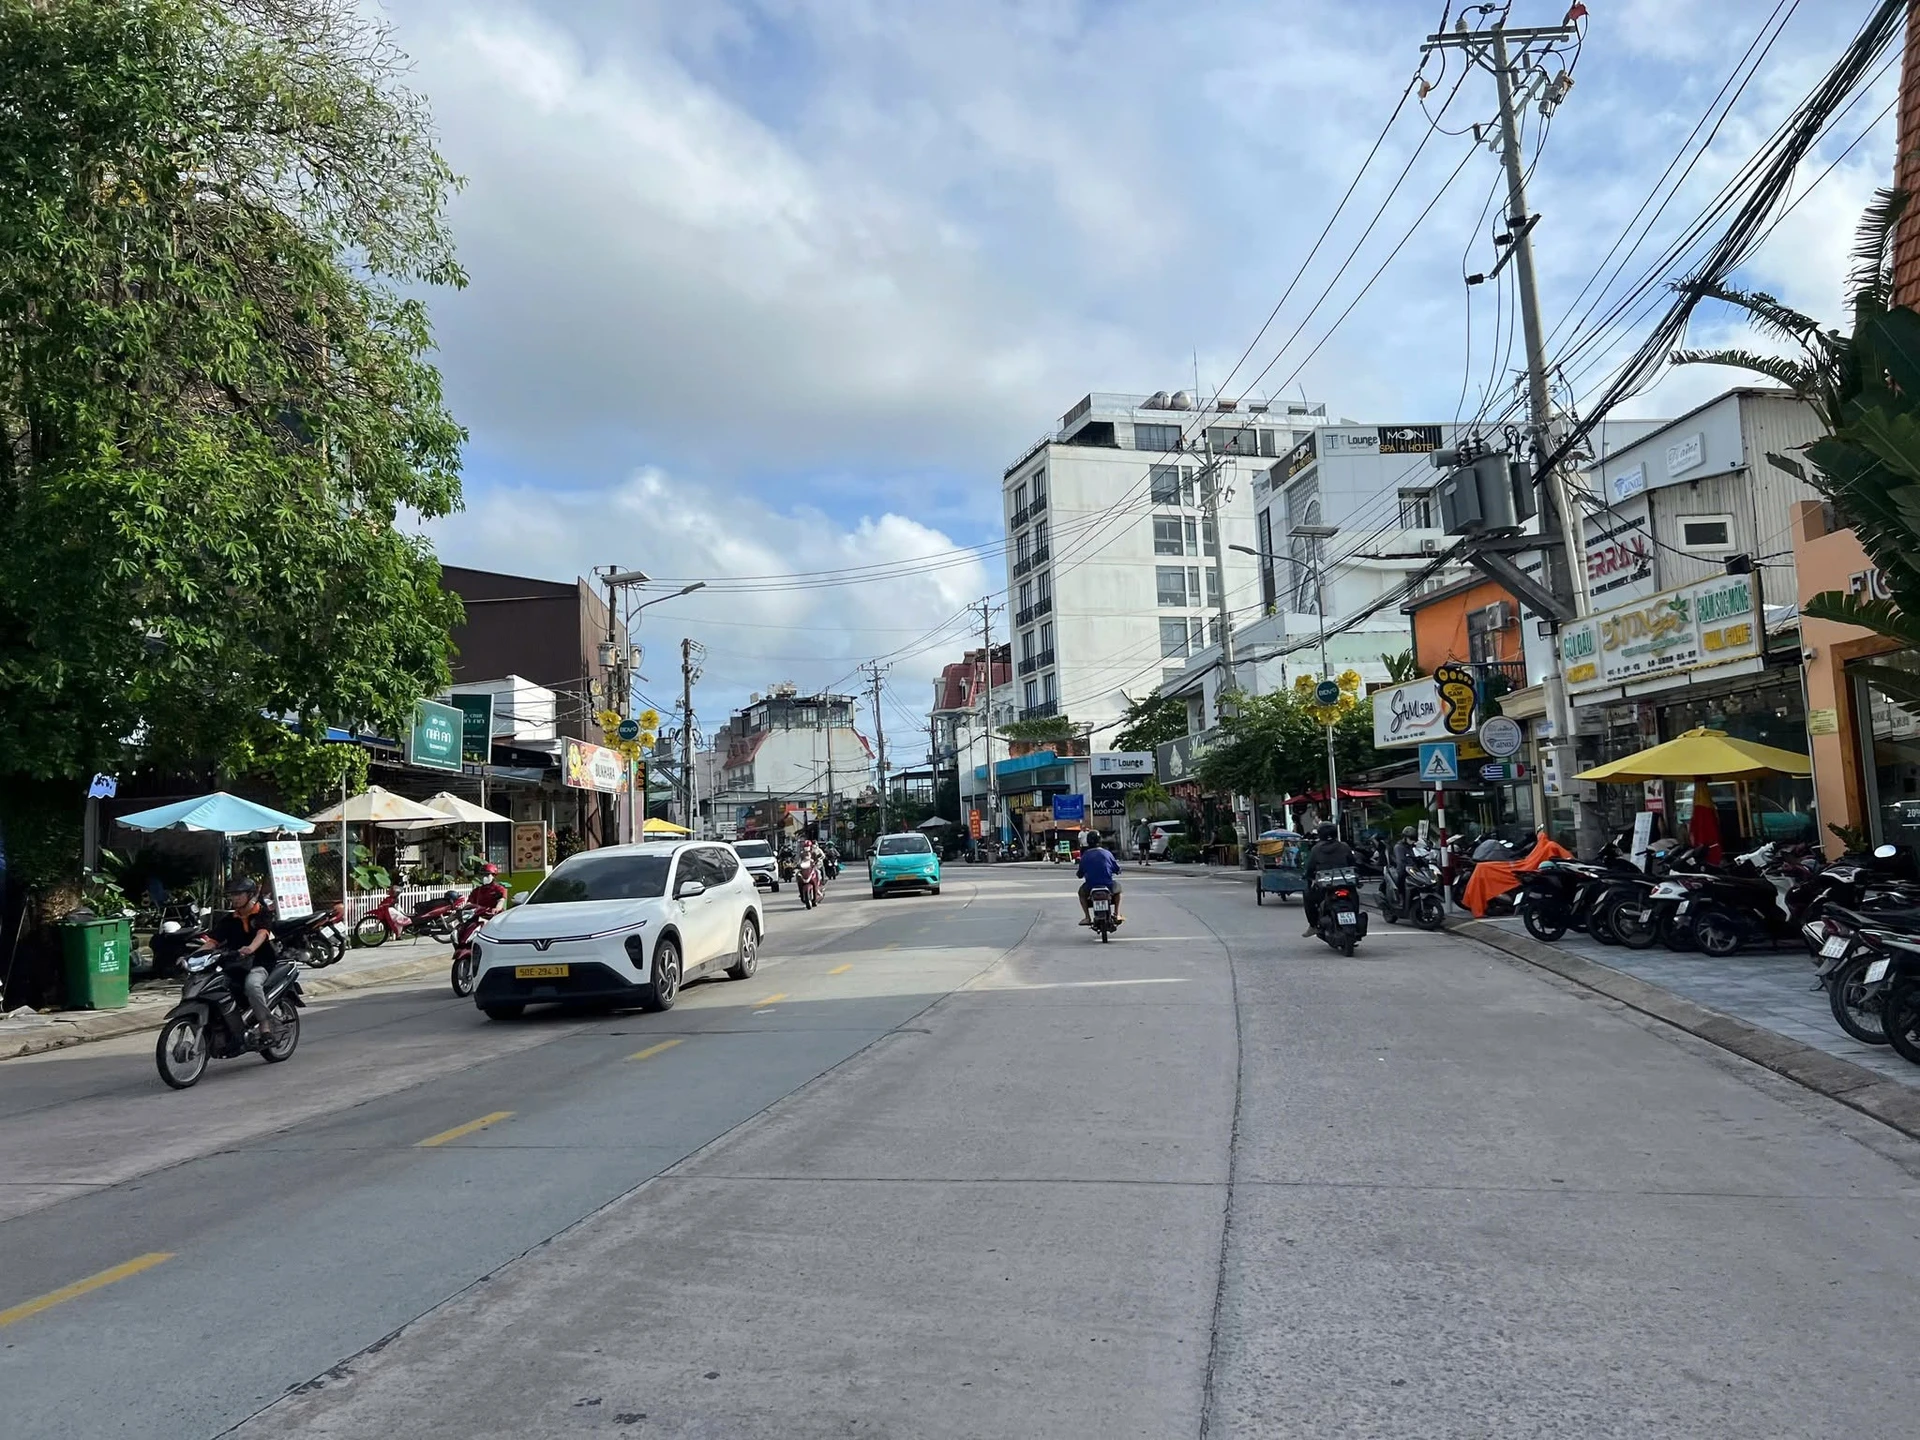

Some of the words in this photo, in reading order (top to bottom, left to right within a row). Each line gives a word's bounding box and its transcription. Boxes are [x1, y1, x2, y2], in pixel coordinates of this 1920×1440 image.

[1347, 434, 1378, 445] Lounge
[1387, 429, 1424, 441] MOON
[1379, 444, 1396, 453] SPA
[1408, 443, 1435, 452] HOTEL
[1420, 702, 1435, 716] SPA
[1118, 759, 1144, 768] Lounge
